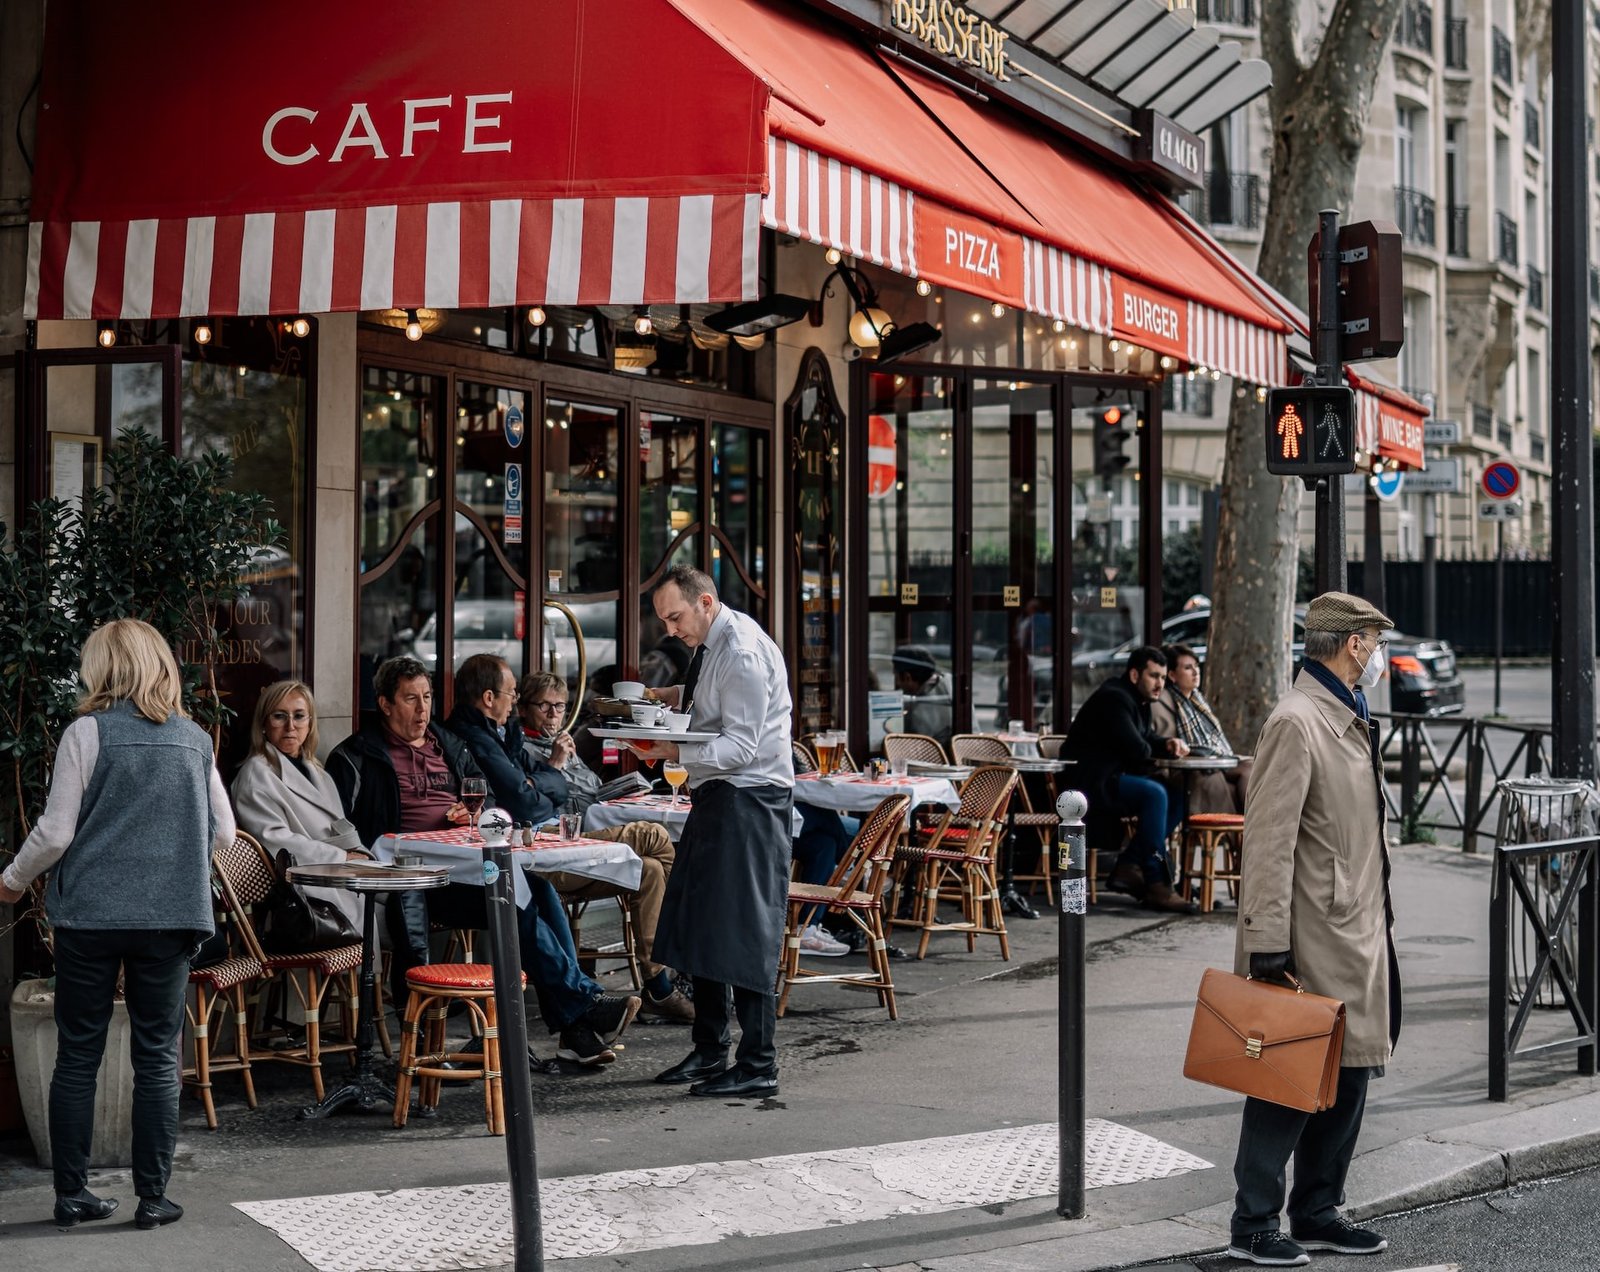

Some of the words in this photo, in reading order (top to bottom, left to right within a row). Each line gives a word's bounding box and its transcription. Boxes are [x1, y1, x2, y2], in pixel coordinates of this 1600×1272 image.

[890, 0, 1011, 82] BRASSERIE
[262, 90, 513, 165] CAFE
[1159, 126, 1199, 174] GLACES
[945, 227, 1001, 280] PIZZA
[1123, 292, 1180, 342] BURGER
[1380, 411, 1405, 447] WINE
[1405, 422, 1422, 453] BAR
